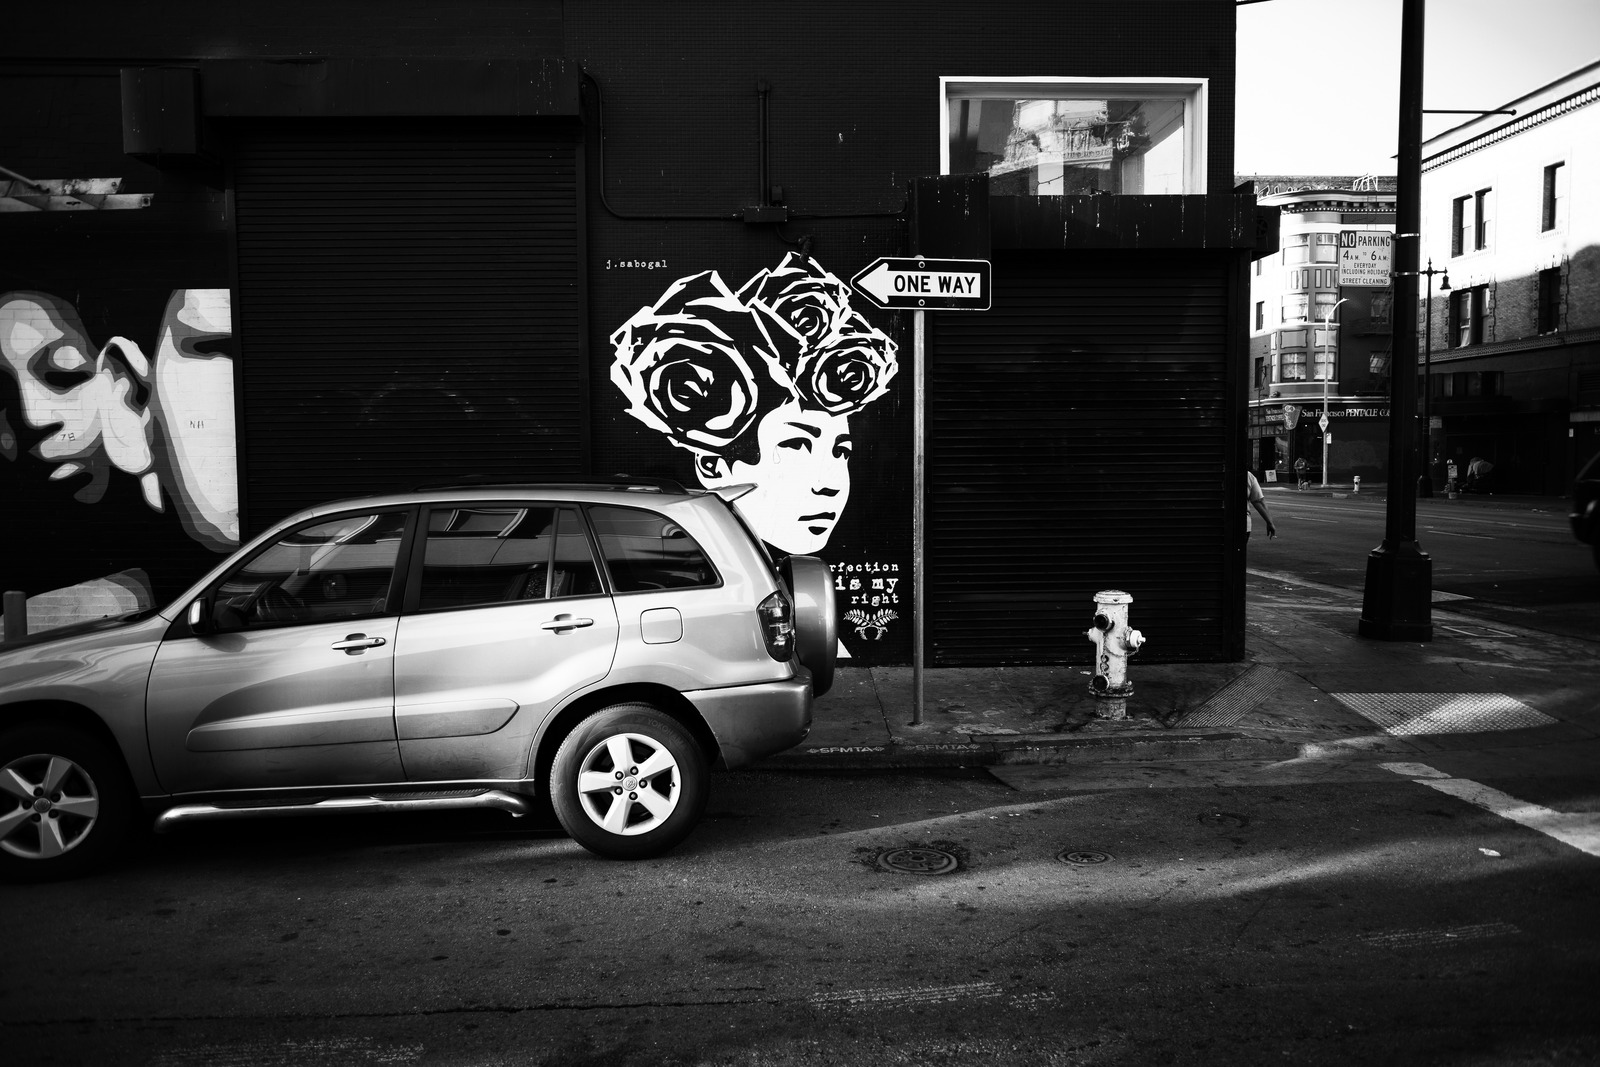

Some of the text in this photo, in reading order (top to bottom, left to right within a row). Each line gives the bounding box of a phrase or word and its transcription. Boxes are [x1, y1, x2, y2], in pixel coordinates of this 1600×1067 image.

[1342, 232, 1390, 246] NO PARKING
[894, 274, 976, 294] ONE WAY
[1301, 409, 1314, 417] San
[1315, 408, 1345, 417] Frncisco
[1345, 408, 1379, 417] PENTACLE
[835, 575, 899, 594] is my
[851, 593, 899, 607] right
[819, 746, 874, 754] SFMTA
